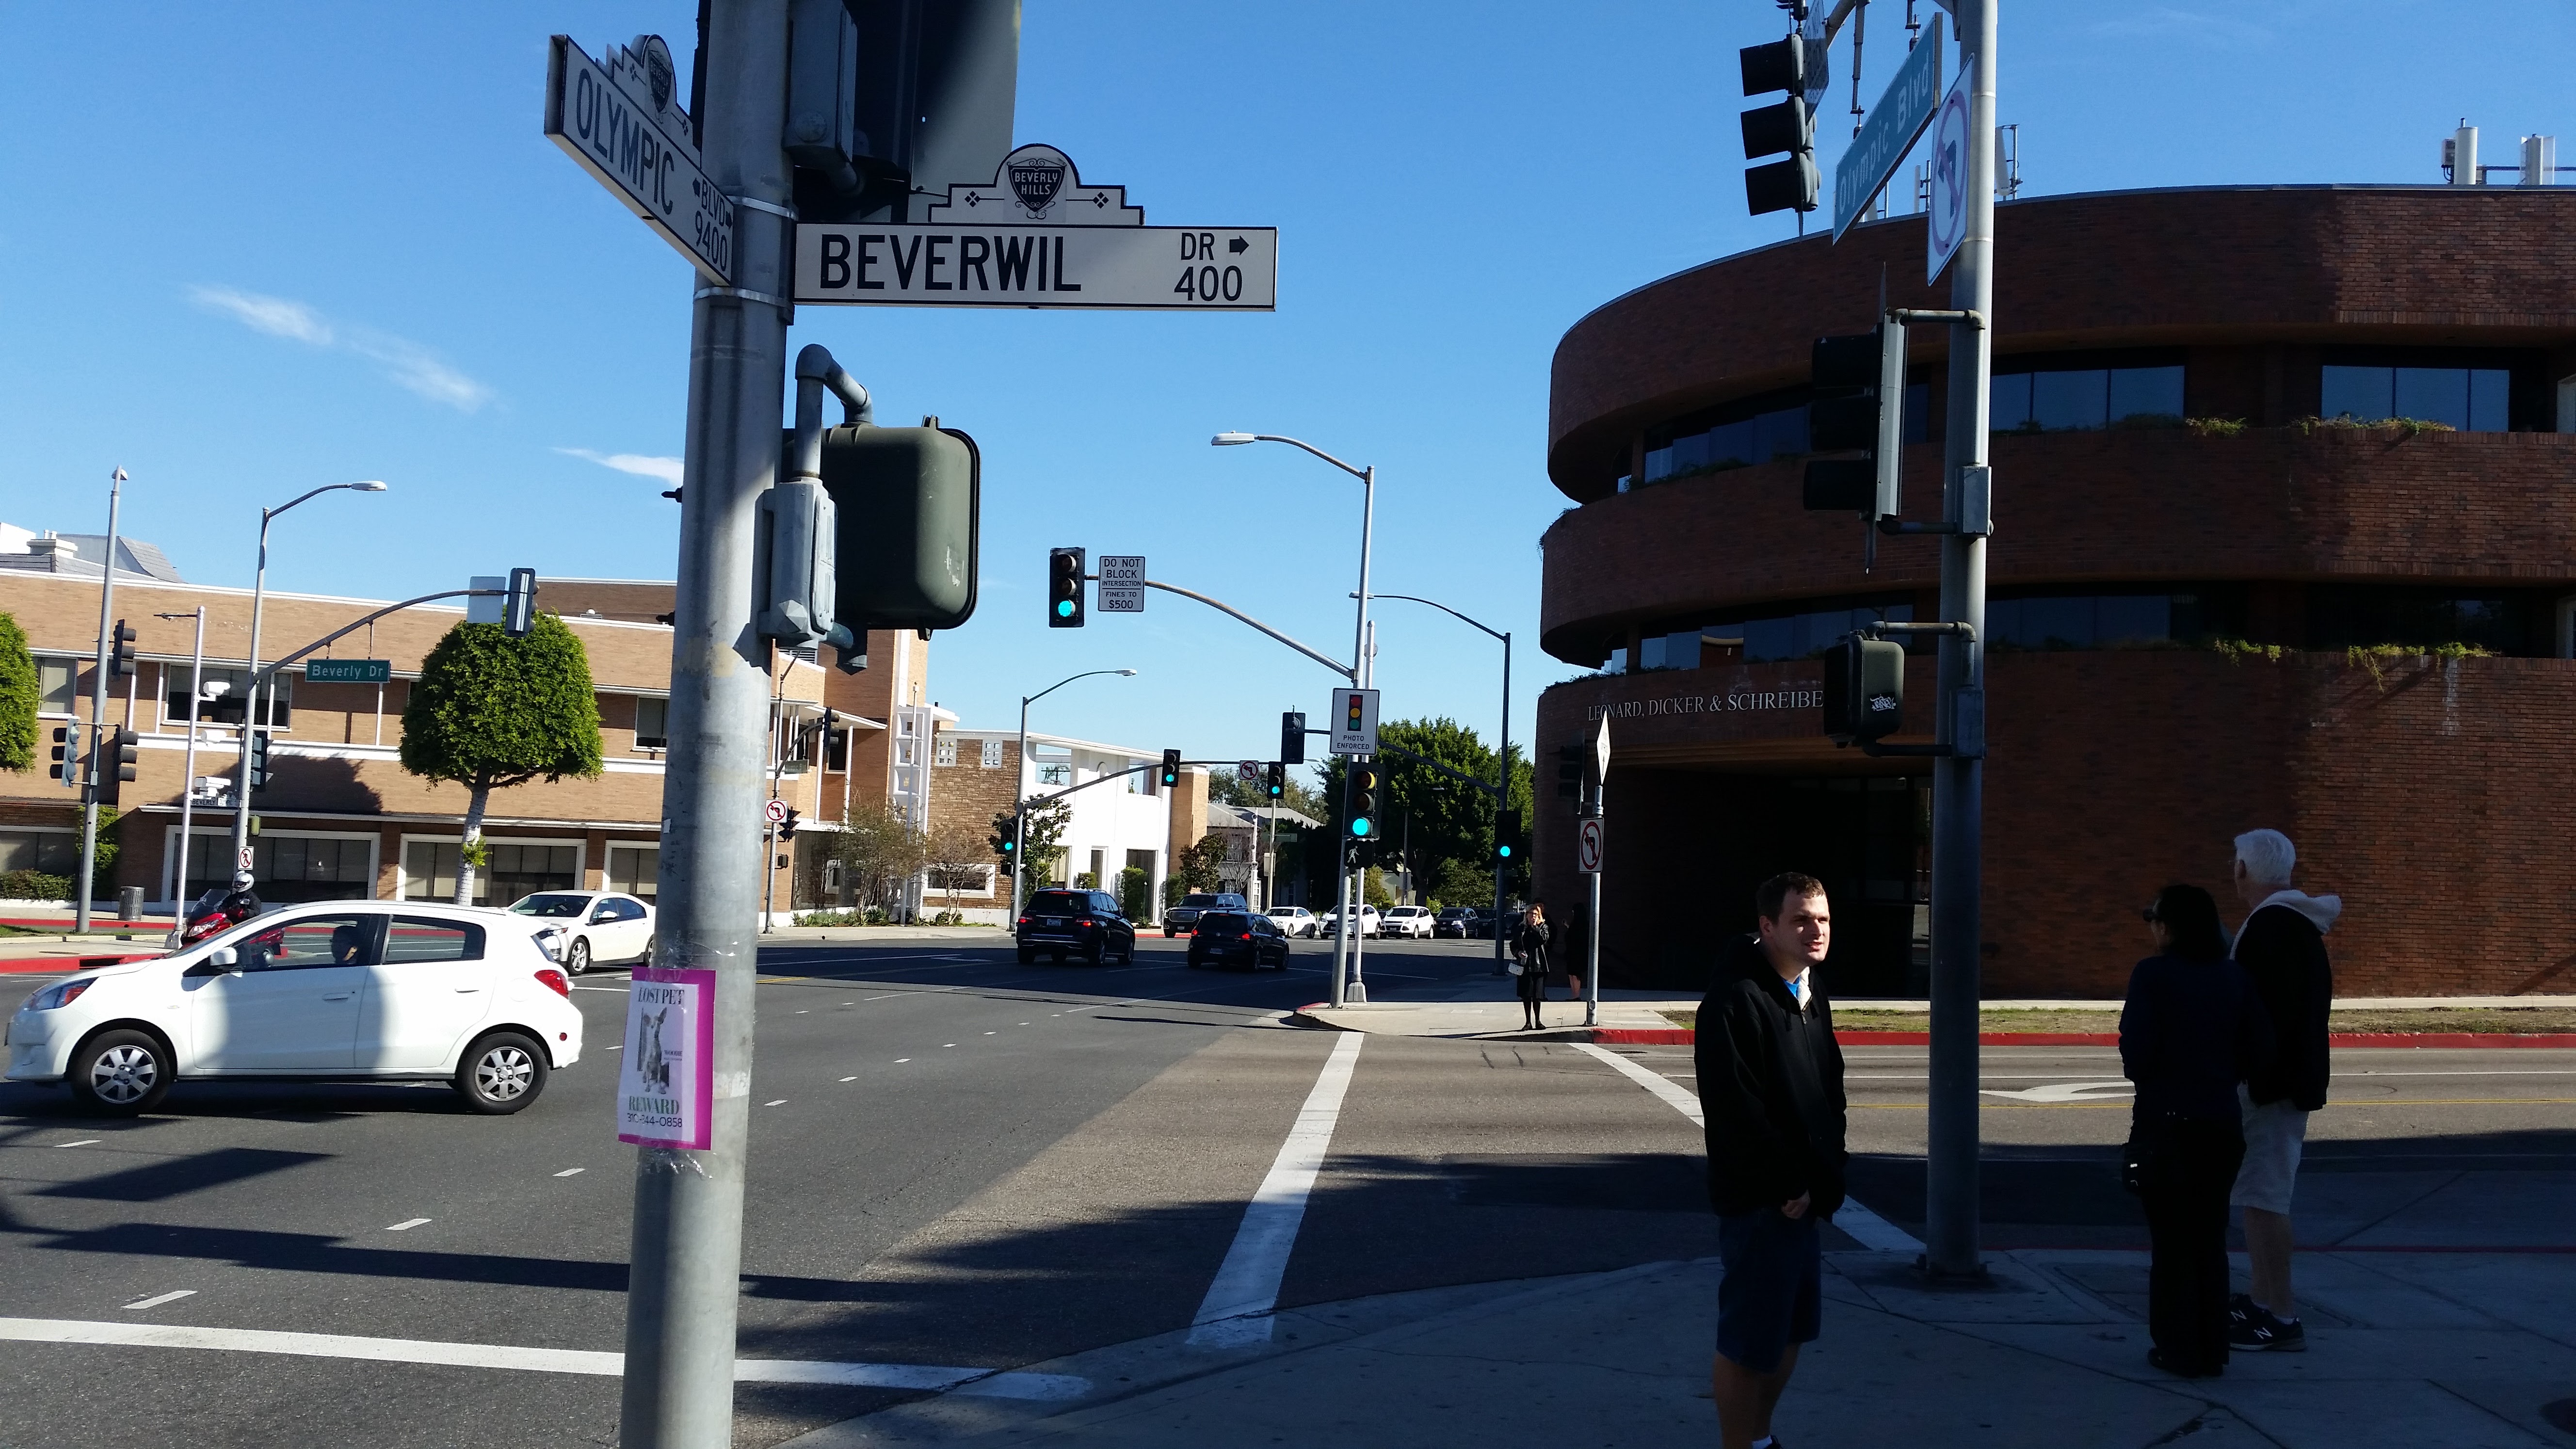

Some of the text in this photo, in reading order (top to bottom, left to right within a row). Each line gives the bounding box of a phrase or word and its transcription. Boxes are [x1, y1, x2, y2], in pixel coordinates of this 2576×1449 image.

[577, 68, 676, 215] OLYMPIC
[1839, 51, 1929, 215] Olympic Blvd
[1014, 172, 1058, 183] BEVERLY
[1021, 184, 1050, 195] HILLS
[701, 180, 727, 227] BLVD
[694, 210, 728, 272] 9400
[820, 232, 1215, 291] BEVERWIL DR
[1174, 265, 1243, 301] 400
[1104, 559, 1141, 568] DO NOT
[1106, 569, 1137, 579] BLOCK
[1109, 599, 1134, 609] $500
[312, 665, 383, 679] Beverly Dr
[1588, 690, 1824, 721] LEONARD, DICKER & SCHREIBE
[638, 987, 685, 1005] LOST PET
[628, 1095, 679, 1115] REWARD
